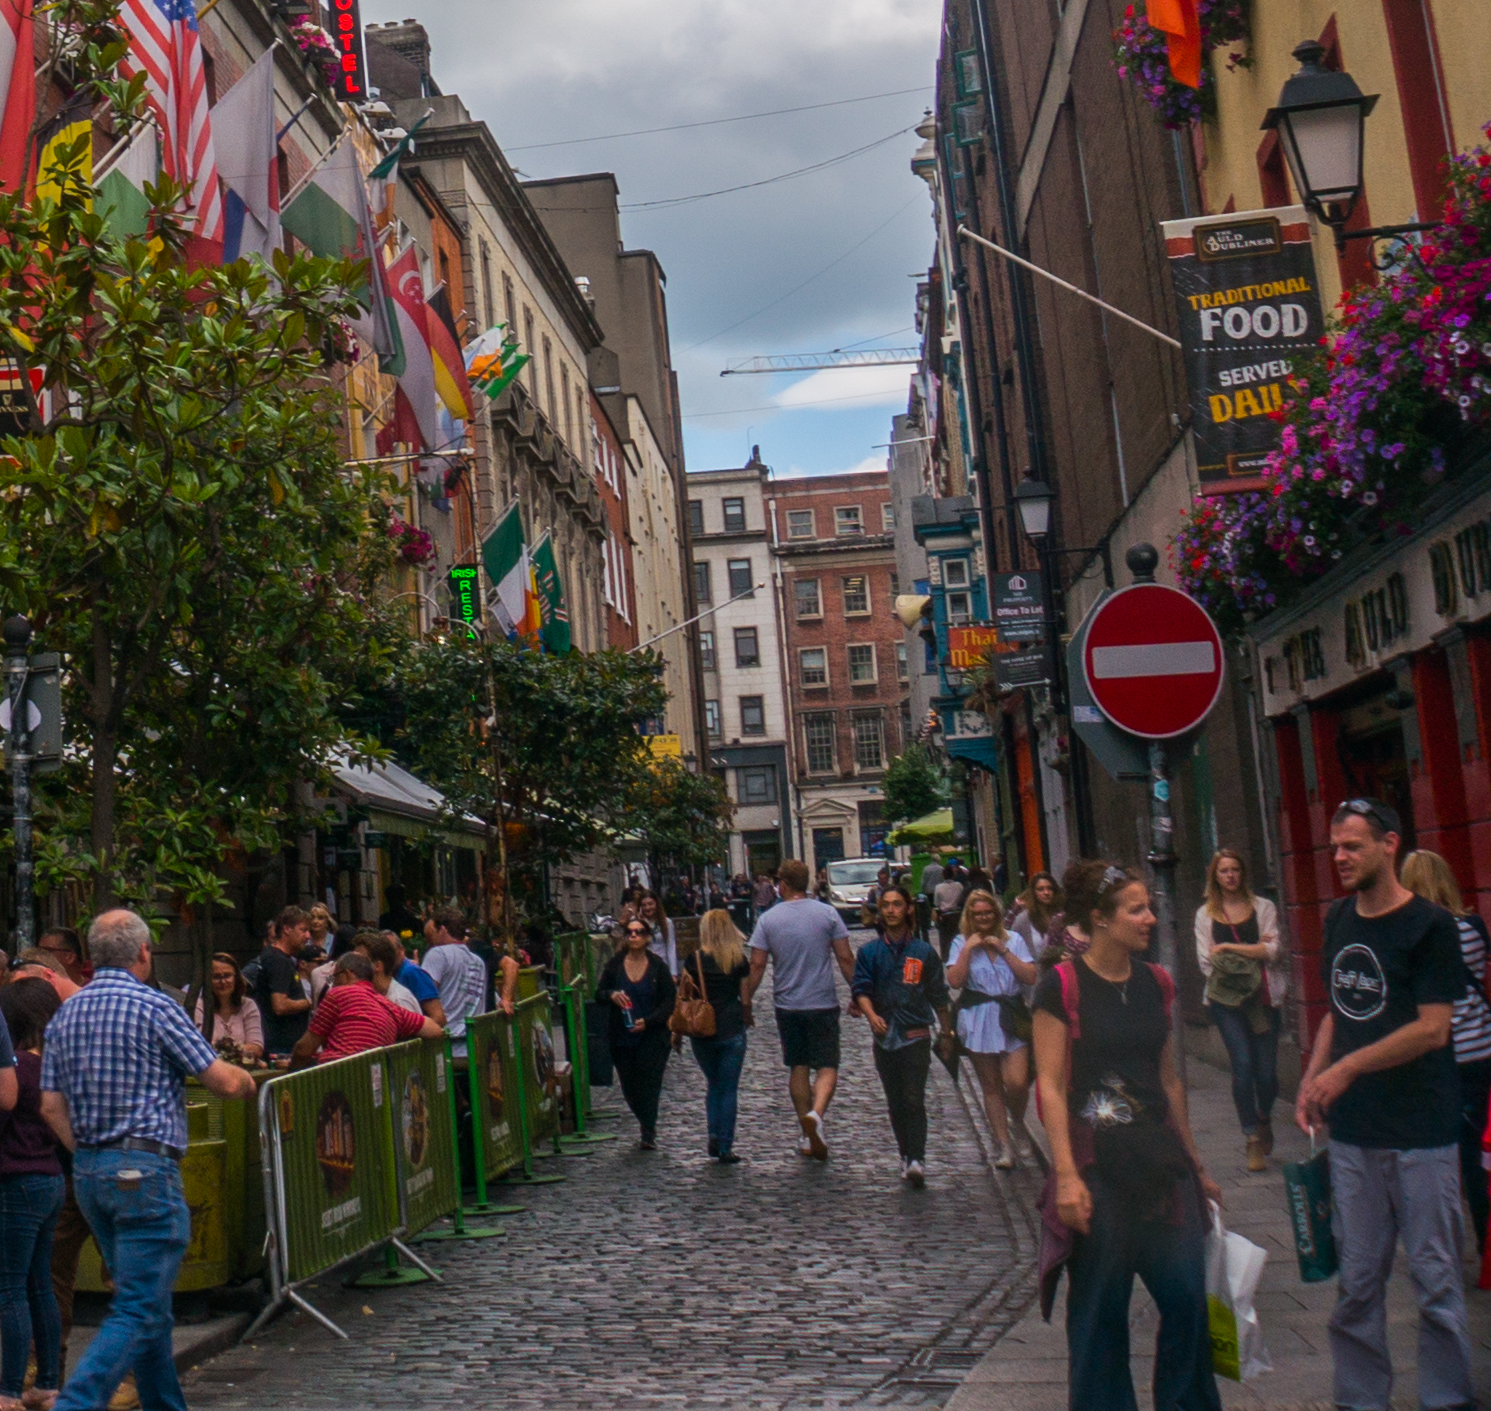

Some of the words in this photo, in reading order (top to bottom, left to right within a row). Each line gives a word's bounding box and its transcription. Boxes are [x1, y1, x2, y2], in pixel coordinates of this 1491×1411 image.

[1207, 232, 1244, 246] AULD
[1208, 237, 1275, 253] DUBLINER
[1188, 275, 1312, 310] TRADITIONAL
[1199, 303, 1309, 342] FOOD
[1218, 358, 1294, 387] SERVED
[450, 568, 477, 579] IRISH
[996, 607, 1019, 616] Office
[1020, 606, 1030, 615] To
[1031, 605, 1044, 614] Let
[961, 629, 998, 646] Thai
